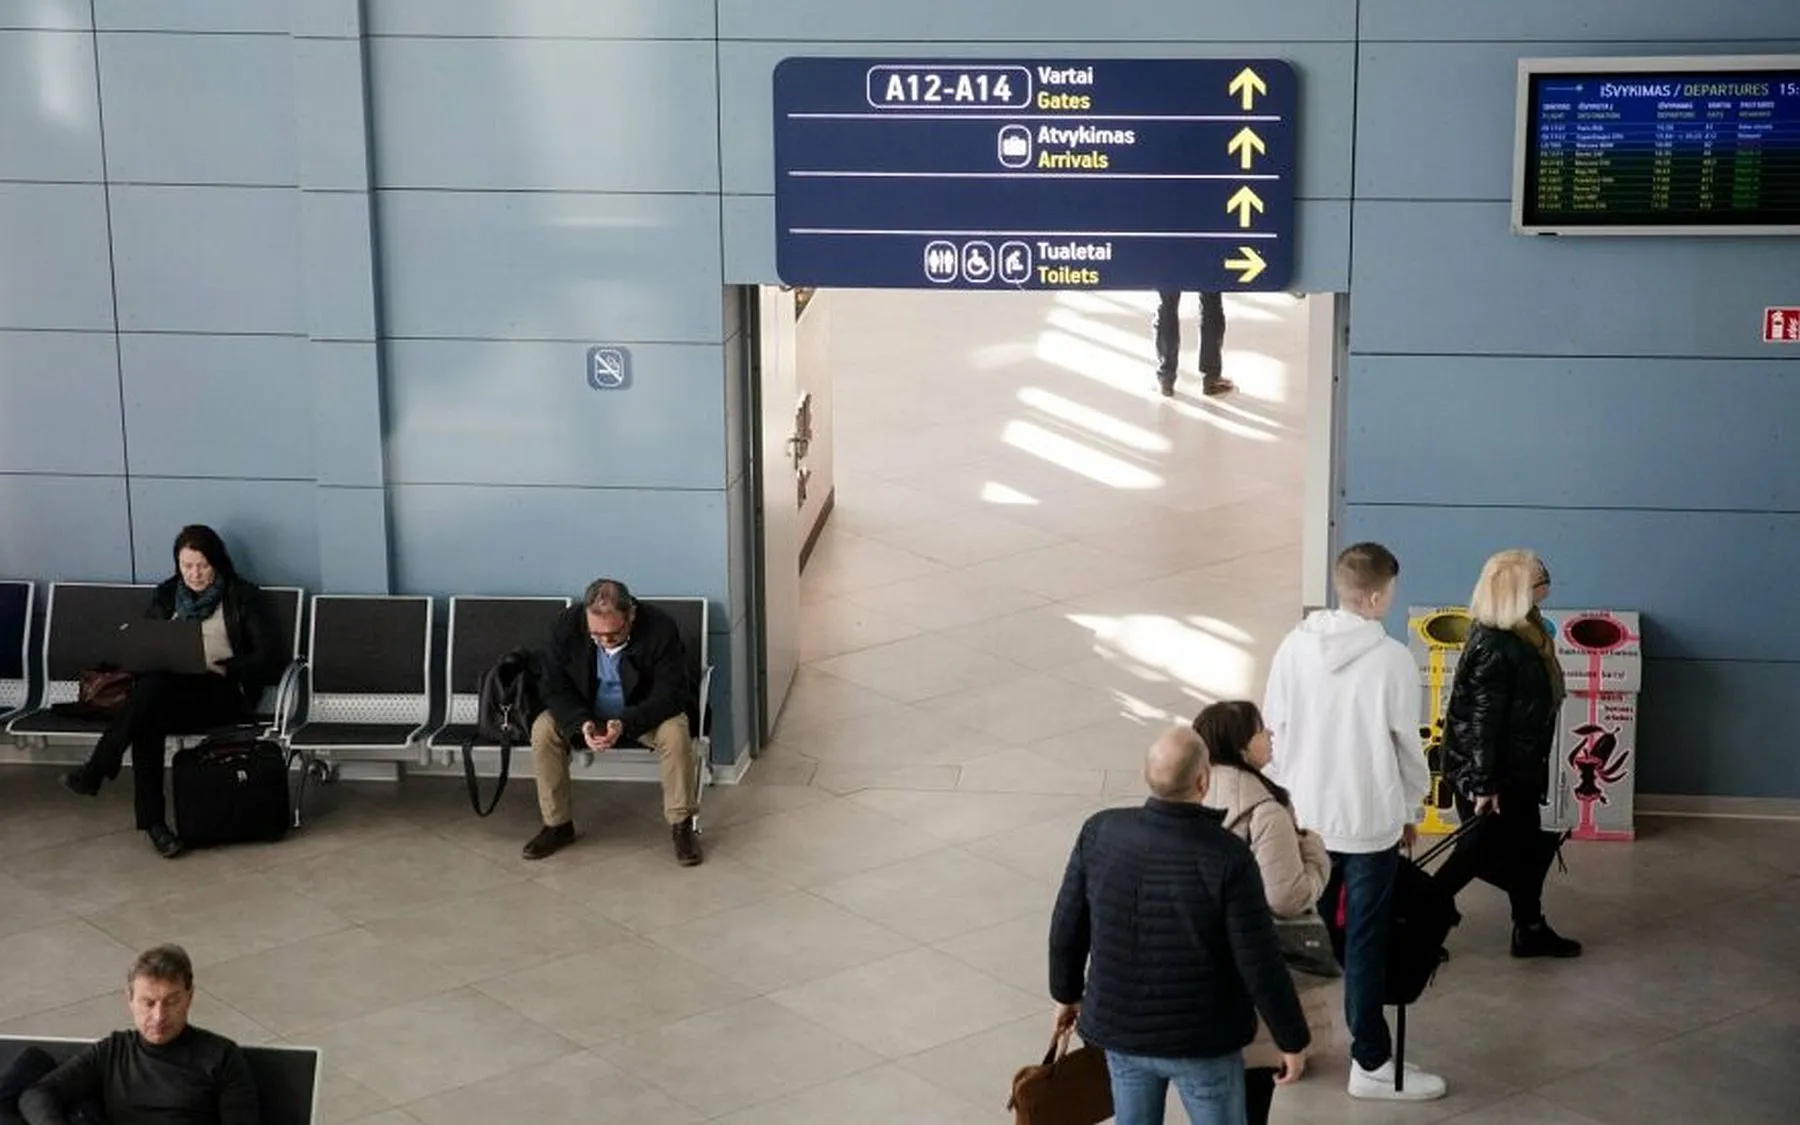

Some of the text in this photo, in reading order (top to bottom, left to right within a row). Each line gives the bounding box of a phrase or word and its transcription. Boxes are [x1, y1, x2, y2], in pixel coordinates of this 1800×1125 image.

[1037, 66, 1094, 85] Vartai
[886, 75, 1013, 102] A12-A14
[1600, 83, 1671, 98] IŠVYKIMAS
[1684, 83, 1769, 97] DEPARTURES
[1037, 91, 1091, 109] Gates
[1038, 125, 1136, 148] Atvykimas
[1038, 150, 1109, 168] Arrivals
[1037, 242, 1112, 261] Tualetai
[1037, 267, 1099, 284] Toilets
